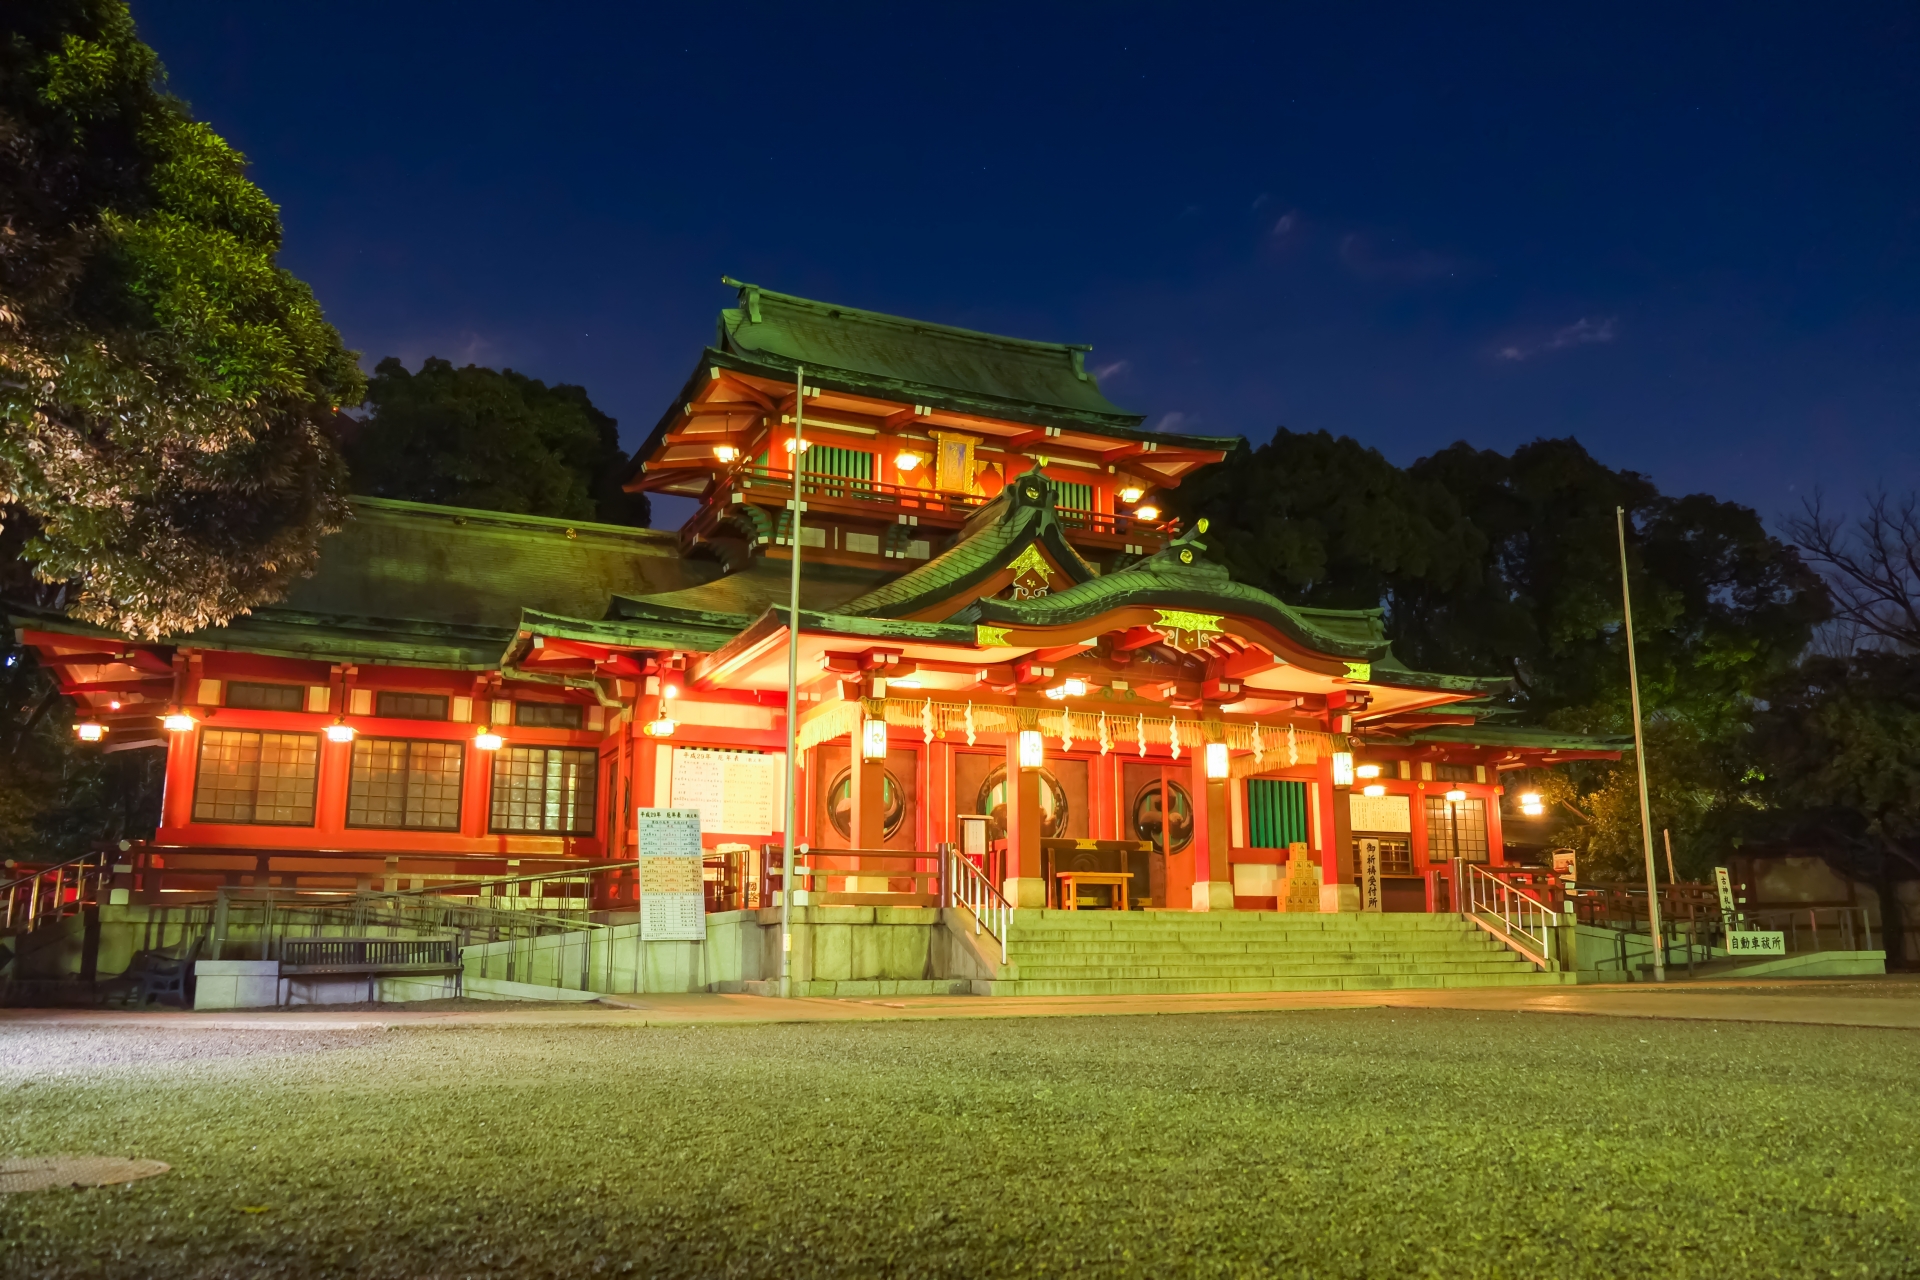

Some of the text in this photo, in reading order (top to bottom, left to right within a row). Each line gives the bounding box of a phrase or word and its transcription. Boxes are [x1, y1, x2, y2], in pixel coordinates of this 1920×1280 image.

[683, 752, 711, 760] 平成29年
[640, 811, 661, 819] 平成29年
[1731, 936, 1781, 950] 自動車祓所
